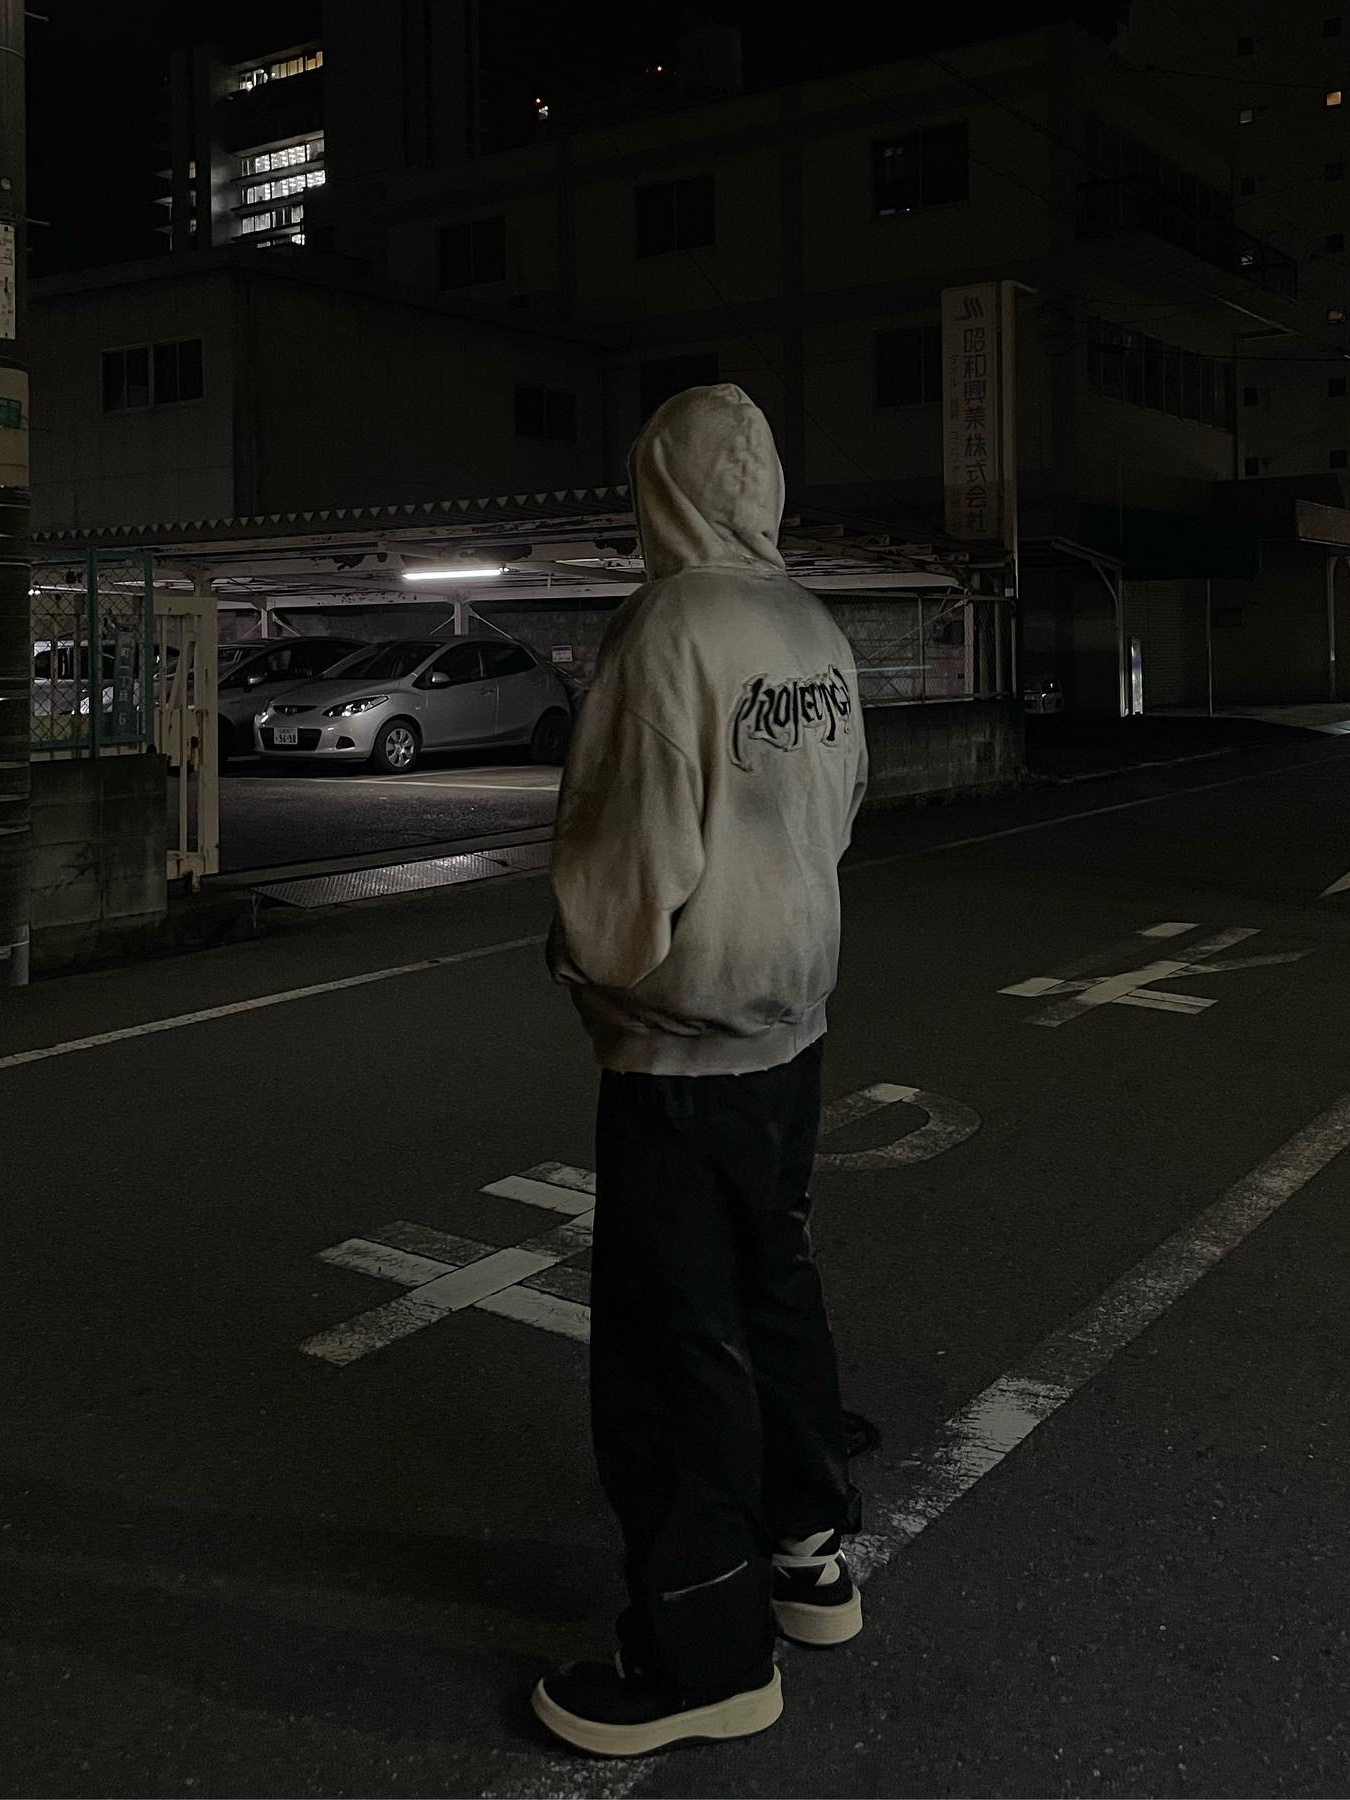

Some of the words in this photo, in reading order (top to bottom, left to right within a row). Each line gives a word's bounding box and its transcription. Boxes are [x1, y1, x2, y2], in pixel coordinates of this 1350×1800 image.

[963, 327, 988, 530] 昭和興業株式会社
